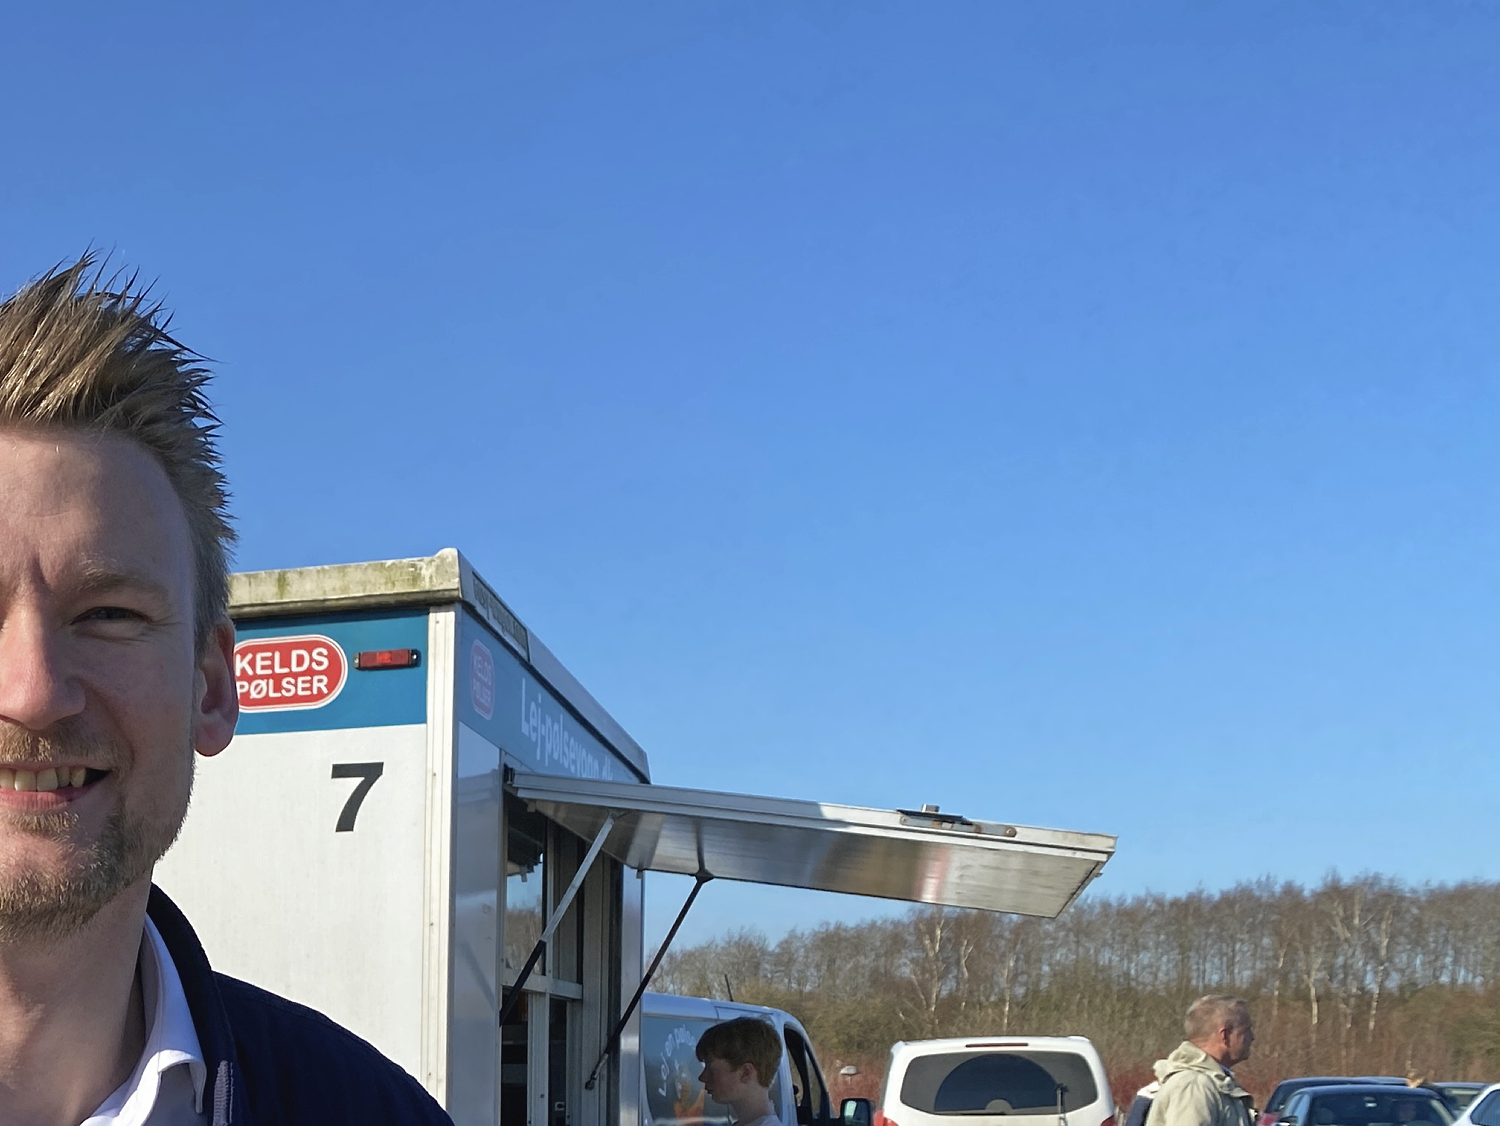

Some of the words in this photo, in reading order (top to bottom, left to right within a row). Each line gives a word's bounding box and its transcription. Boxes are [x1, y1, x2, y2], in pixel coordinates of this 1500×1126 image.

[235, 647, 329, 677] KELDS
[235, 674, 329, 700] PØLSER
[331, 761, 384, 833] 7
